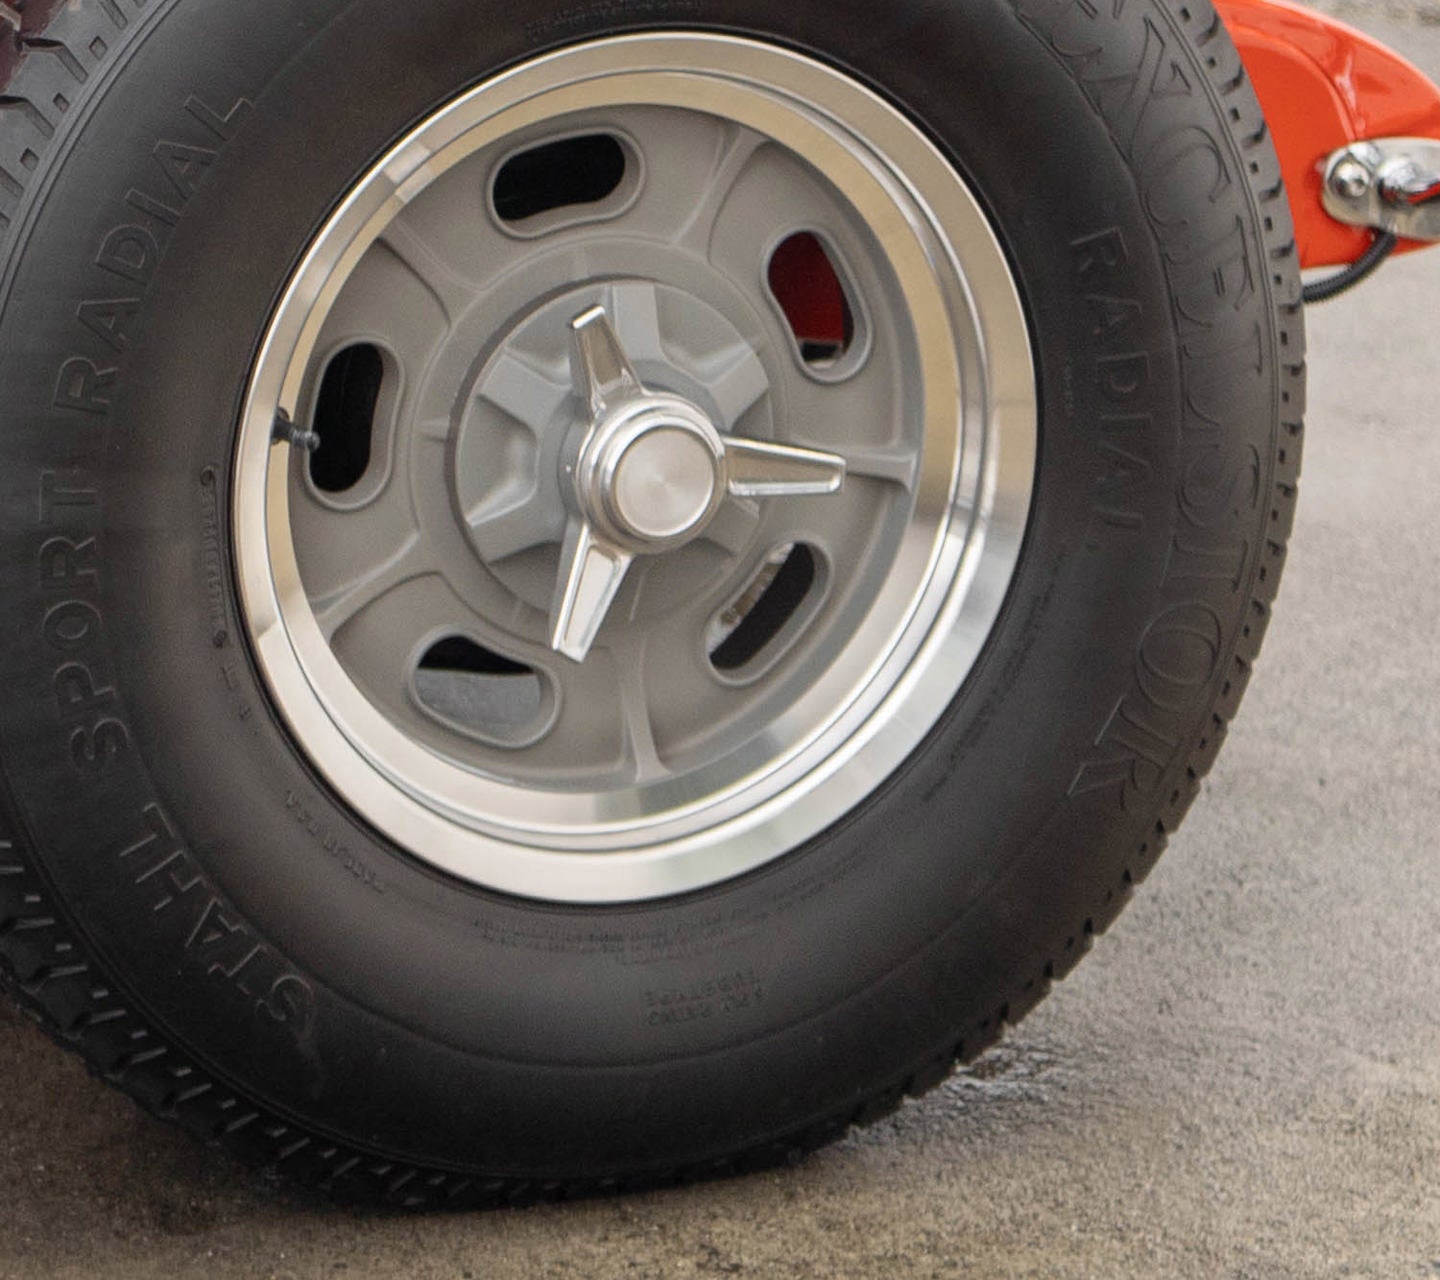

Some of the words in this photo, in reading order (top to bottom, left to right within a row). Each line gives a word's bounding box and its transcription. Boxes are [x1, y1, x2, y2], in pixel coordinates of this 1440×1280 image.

[51, 93, 257, 417] RADIAL
[1069, 225, 1155, 546] RADIAL
[36, 469, 130, 772] SPORT
[118, 800, 316, 1040] STAHL
